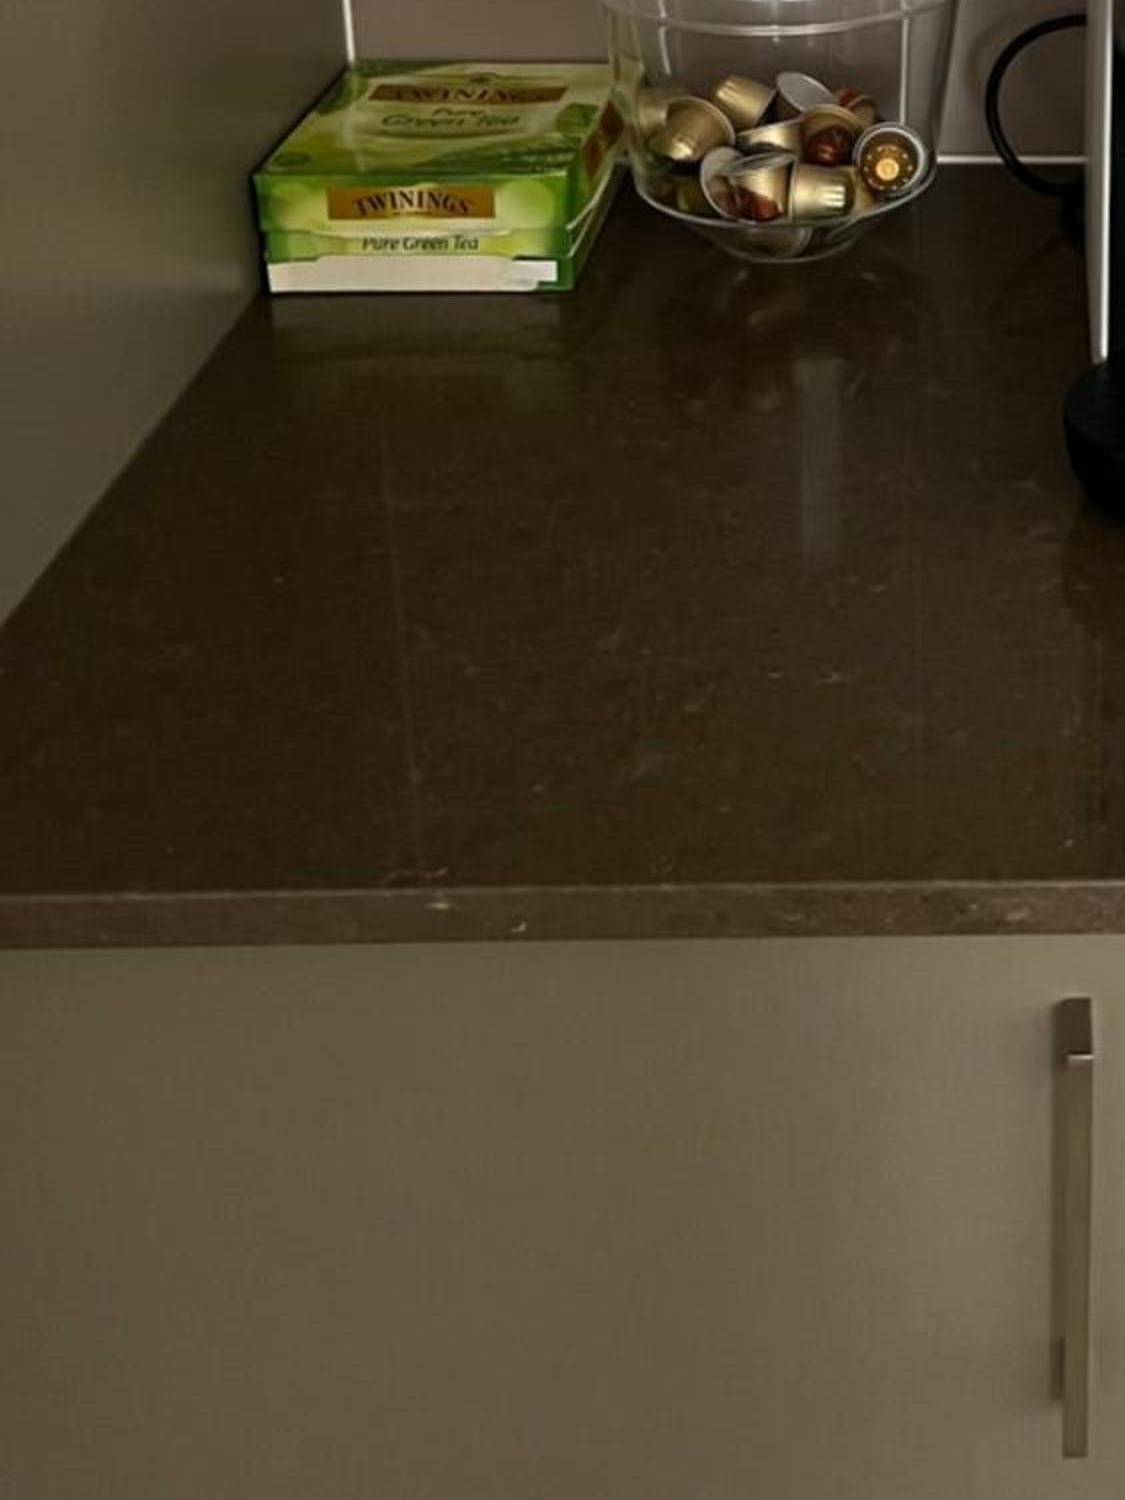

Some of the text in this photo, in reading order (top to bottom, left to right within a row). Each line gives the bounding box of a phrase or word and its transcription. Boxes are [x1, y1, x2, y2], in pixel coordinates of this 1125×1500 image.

[353, 188, 474, 216] TWININGS
[361, 234, 479, 251] Pure Green Tea
